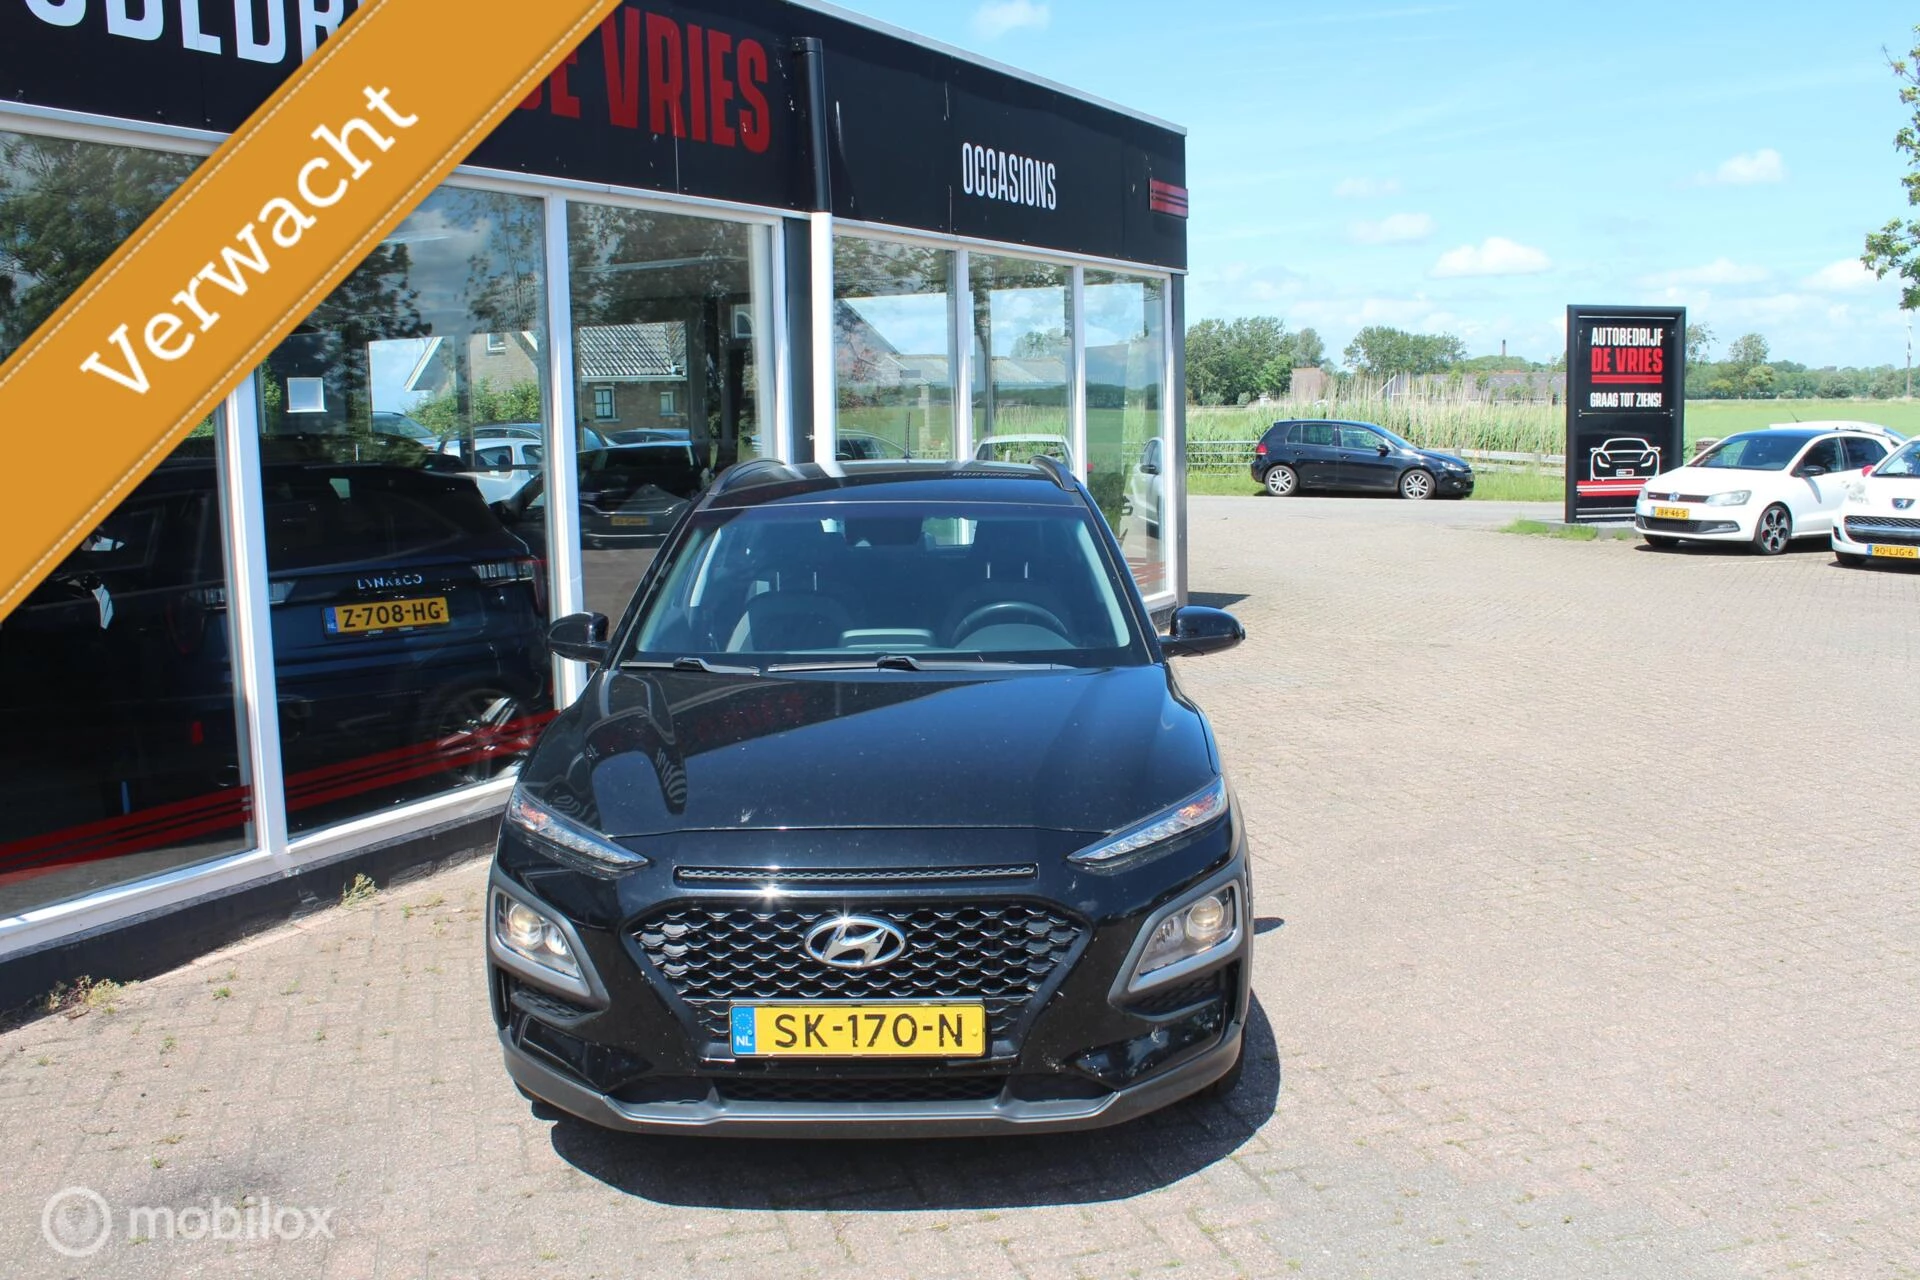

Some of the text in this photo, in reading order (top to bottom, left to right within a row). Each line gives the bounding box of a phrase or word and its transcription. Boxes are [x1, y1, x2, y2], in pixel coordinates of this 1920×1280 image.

[600, 5, 771, 154] VRIES
[962, 142, 1057, 211] OCCASIONS
[1591, 327, 1663, 347] AUTOBEDRIJF
[1591, 347, 1664, 373] DE VRIES
[1590, 392, 1663, 408] GRAAG TOT ZIENS!
[342, 601, 441, 628] Z-708-HG
[736, 1036, 752, 1046] NL
[774, 1013, 964, 1048] SK-170-N
